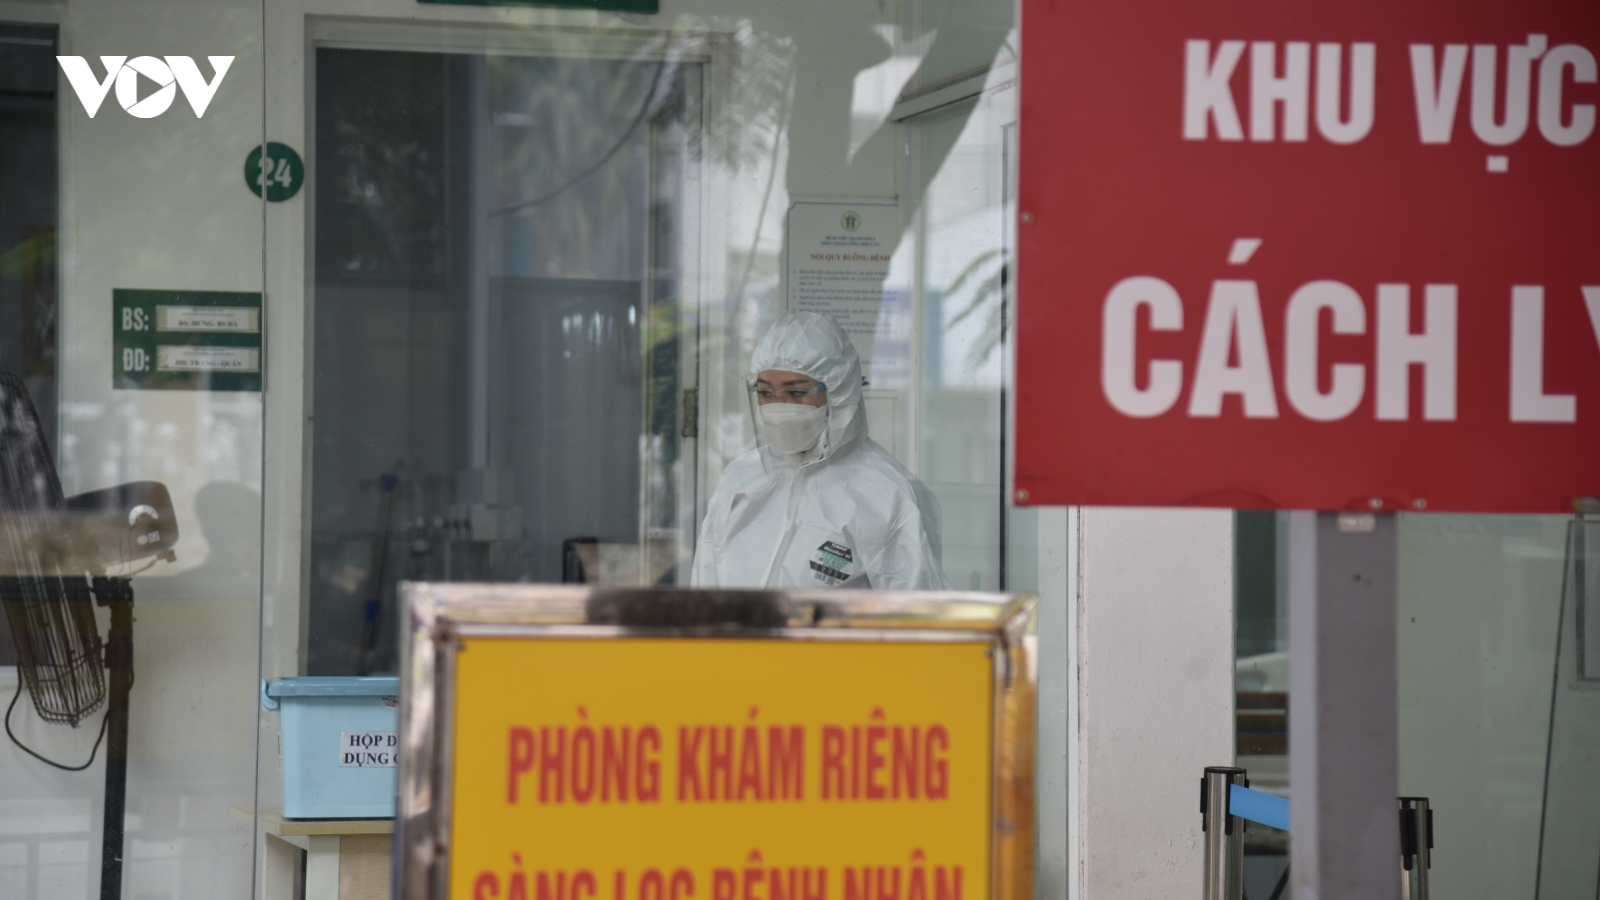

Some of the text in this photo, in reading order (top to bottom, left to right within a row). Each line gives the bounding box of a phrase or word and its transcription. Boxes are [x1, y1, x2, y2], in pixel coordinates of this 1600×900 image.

[1182, 33, 1598, 173] KHU VỰC
[256, 156, 292, 187] 24
[825, 253, 841, 261] QUY
[122, 307, 149, 331] BS:
[1101, 238, 1600, 423] CÁCH L
[123, 348, 150, 372] ĐD:
[349, 733, 383, 749] HỘP
[344, 752, 389, 767] DỤNG
[507, 706, 950, 804] PHÒNG KHÁM RIÊNG
